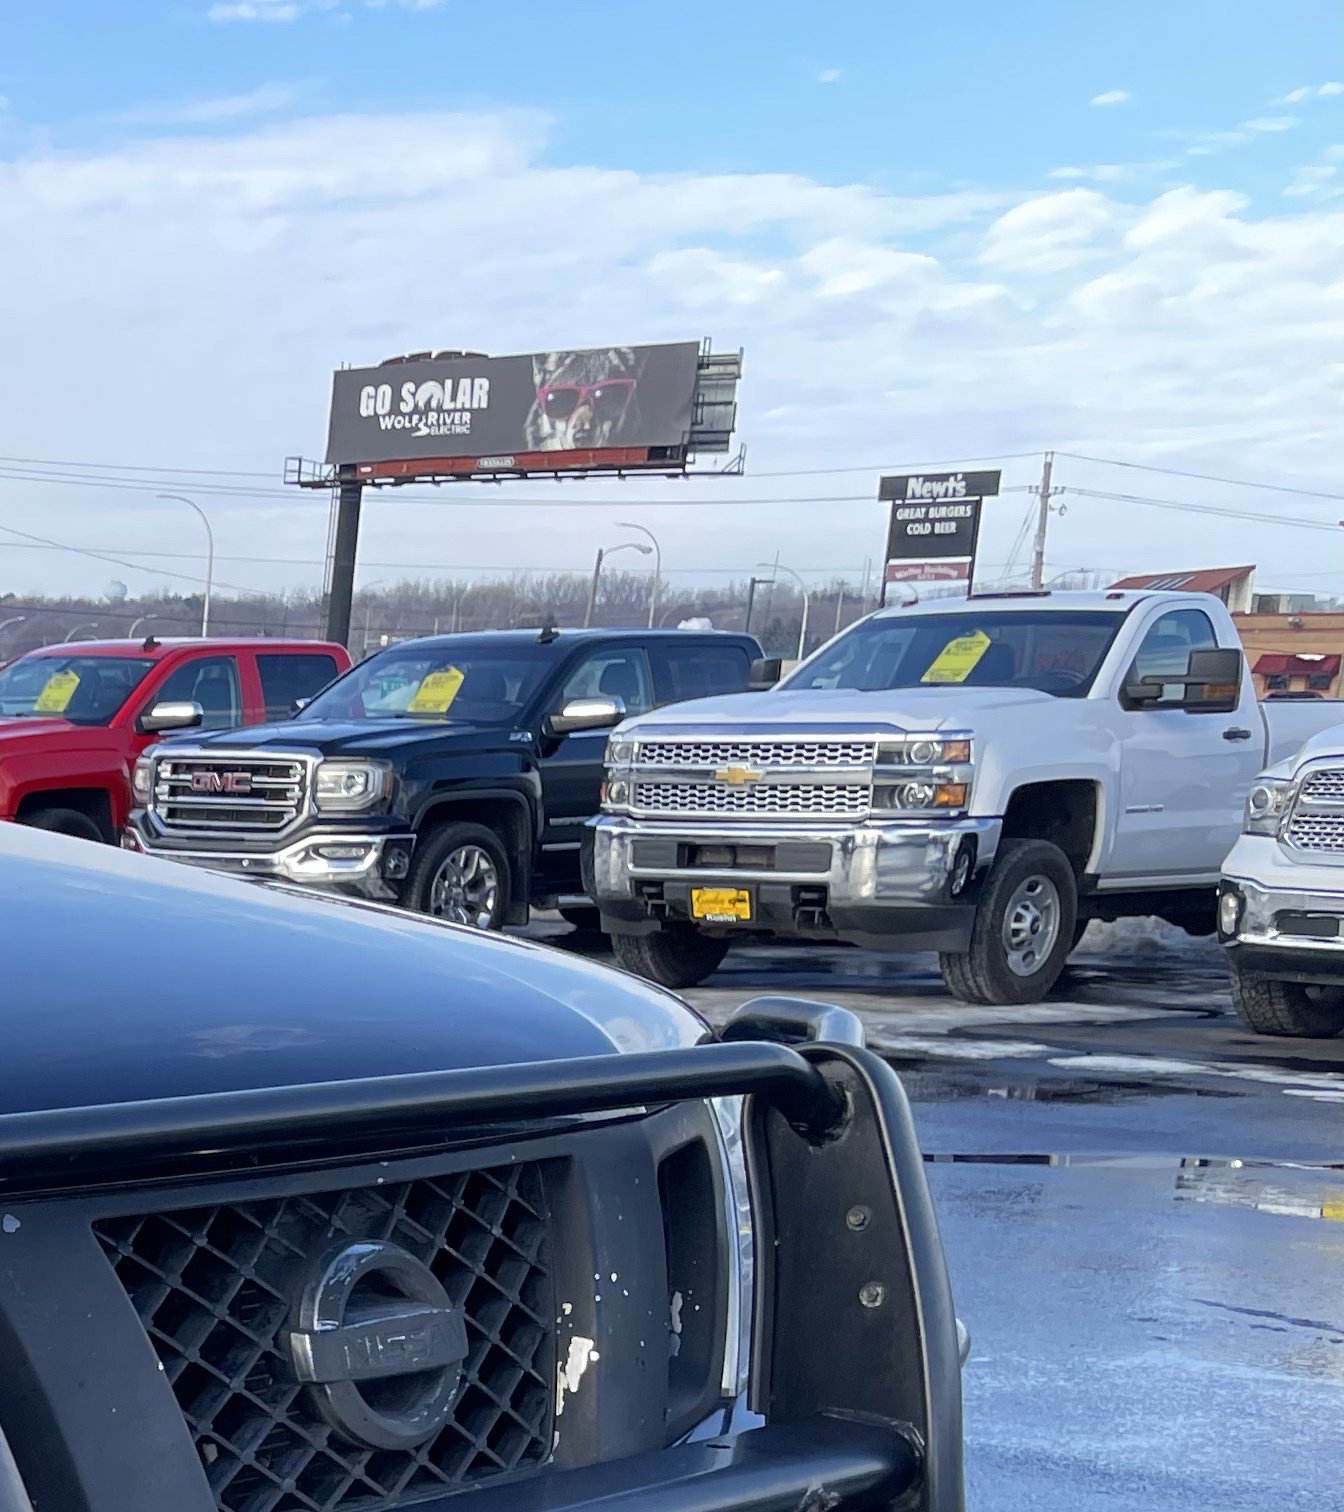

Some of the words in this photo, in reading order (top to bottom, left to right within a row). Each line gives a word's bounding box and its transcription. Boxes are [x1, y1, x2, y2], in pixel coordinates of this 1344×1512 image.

[359, 384, 393, 417] GO
[399, 377, 490, 413] SOLAR
[379, 414, 419, 430] WOLF
[427, 412, 472, 426] RIVER
[429, 425, 471, 435] ELECTRIC
[906, 473, 967, 498] Newt's
[896, 506, 927, 520] GREAT
[928, 504, 972, 519] BURGERS
[907, 522, 931, 535] COLD
[934, 521, 957, 534] BEER
[192, 771, 252, 793] GMC
